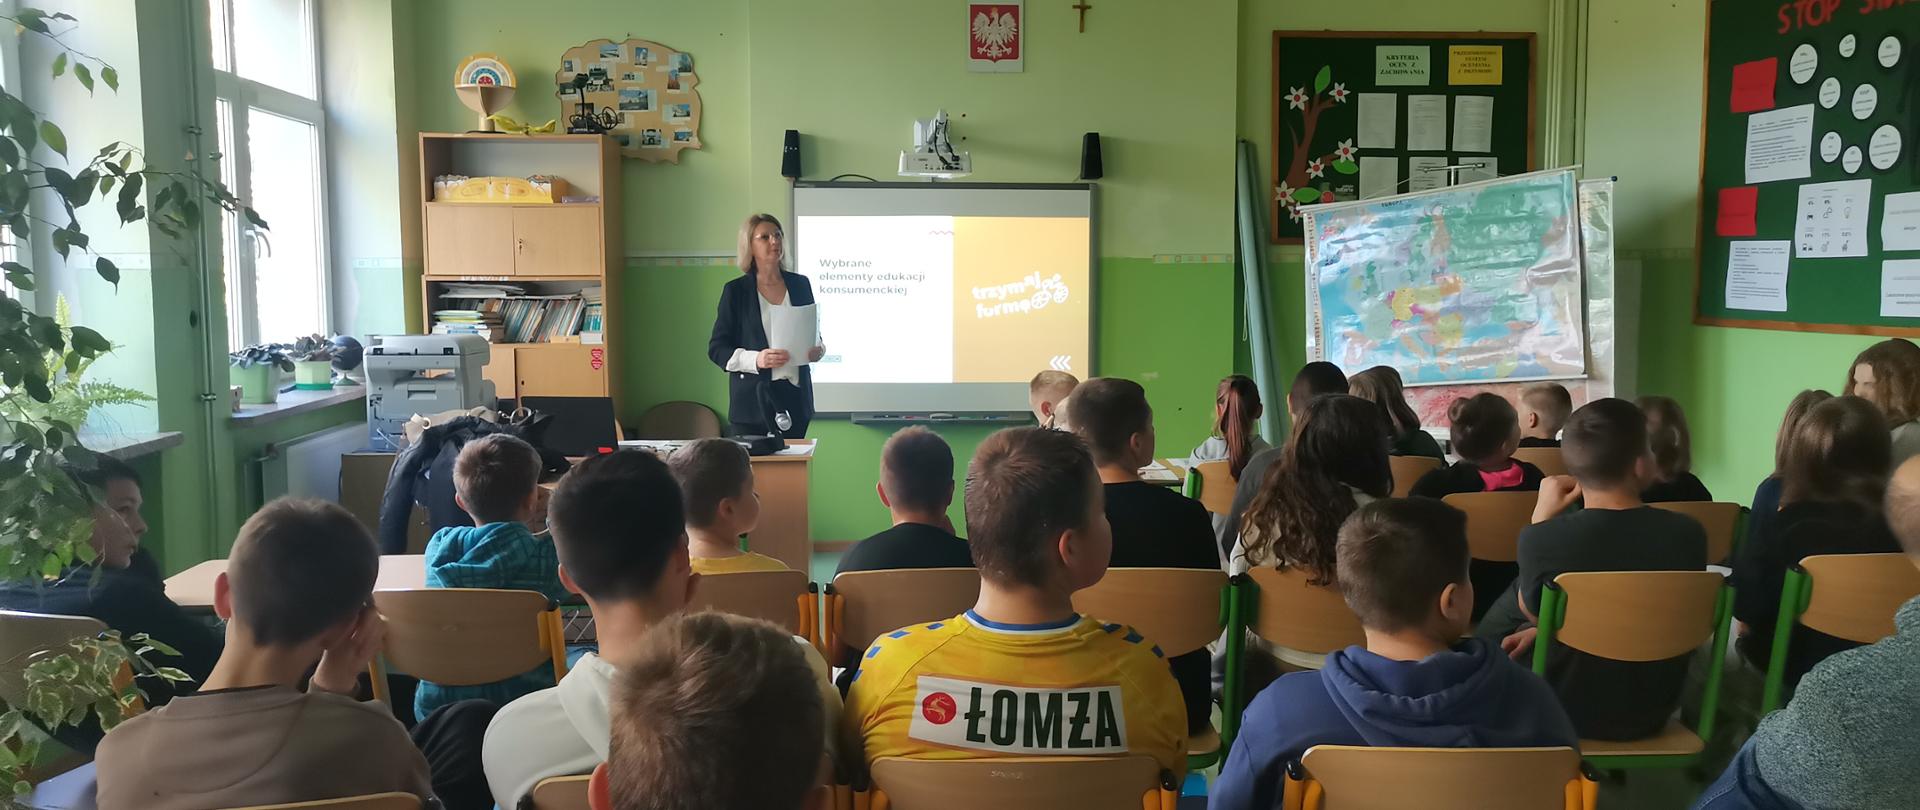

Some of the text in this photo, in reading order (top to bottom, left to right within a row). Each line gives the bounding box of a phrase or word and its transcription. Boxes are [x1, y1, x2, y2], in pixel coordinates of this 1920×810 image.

[1777, 0, 1840, 34] STOP
[819, 258, 872, 270] Wybrane
[819, 271, 925, 283] elementy edukacji
[819, 285, 907, 297] konsumenckiej
[964, 687, 1121, 749] ŁOMŻA
